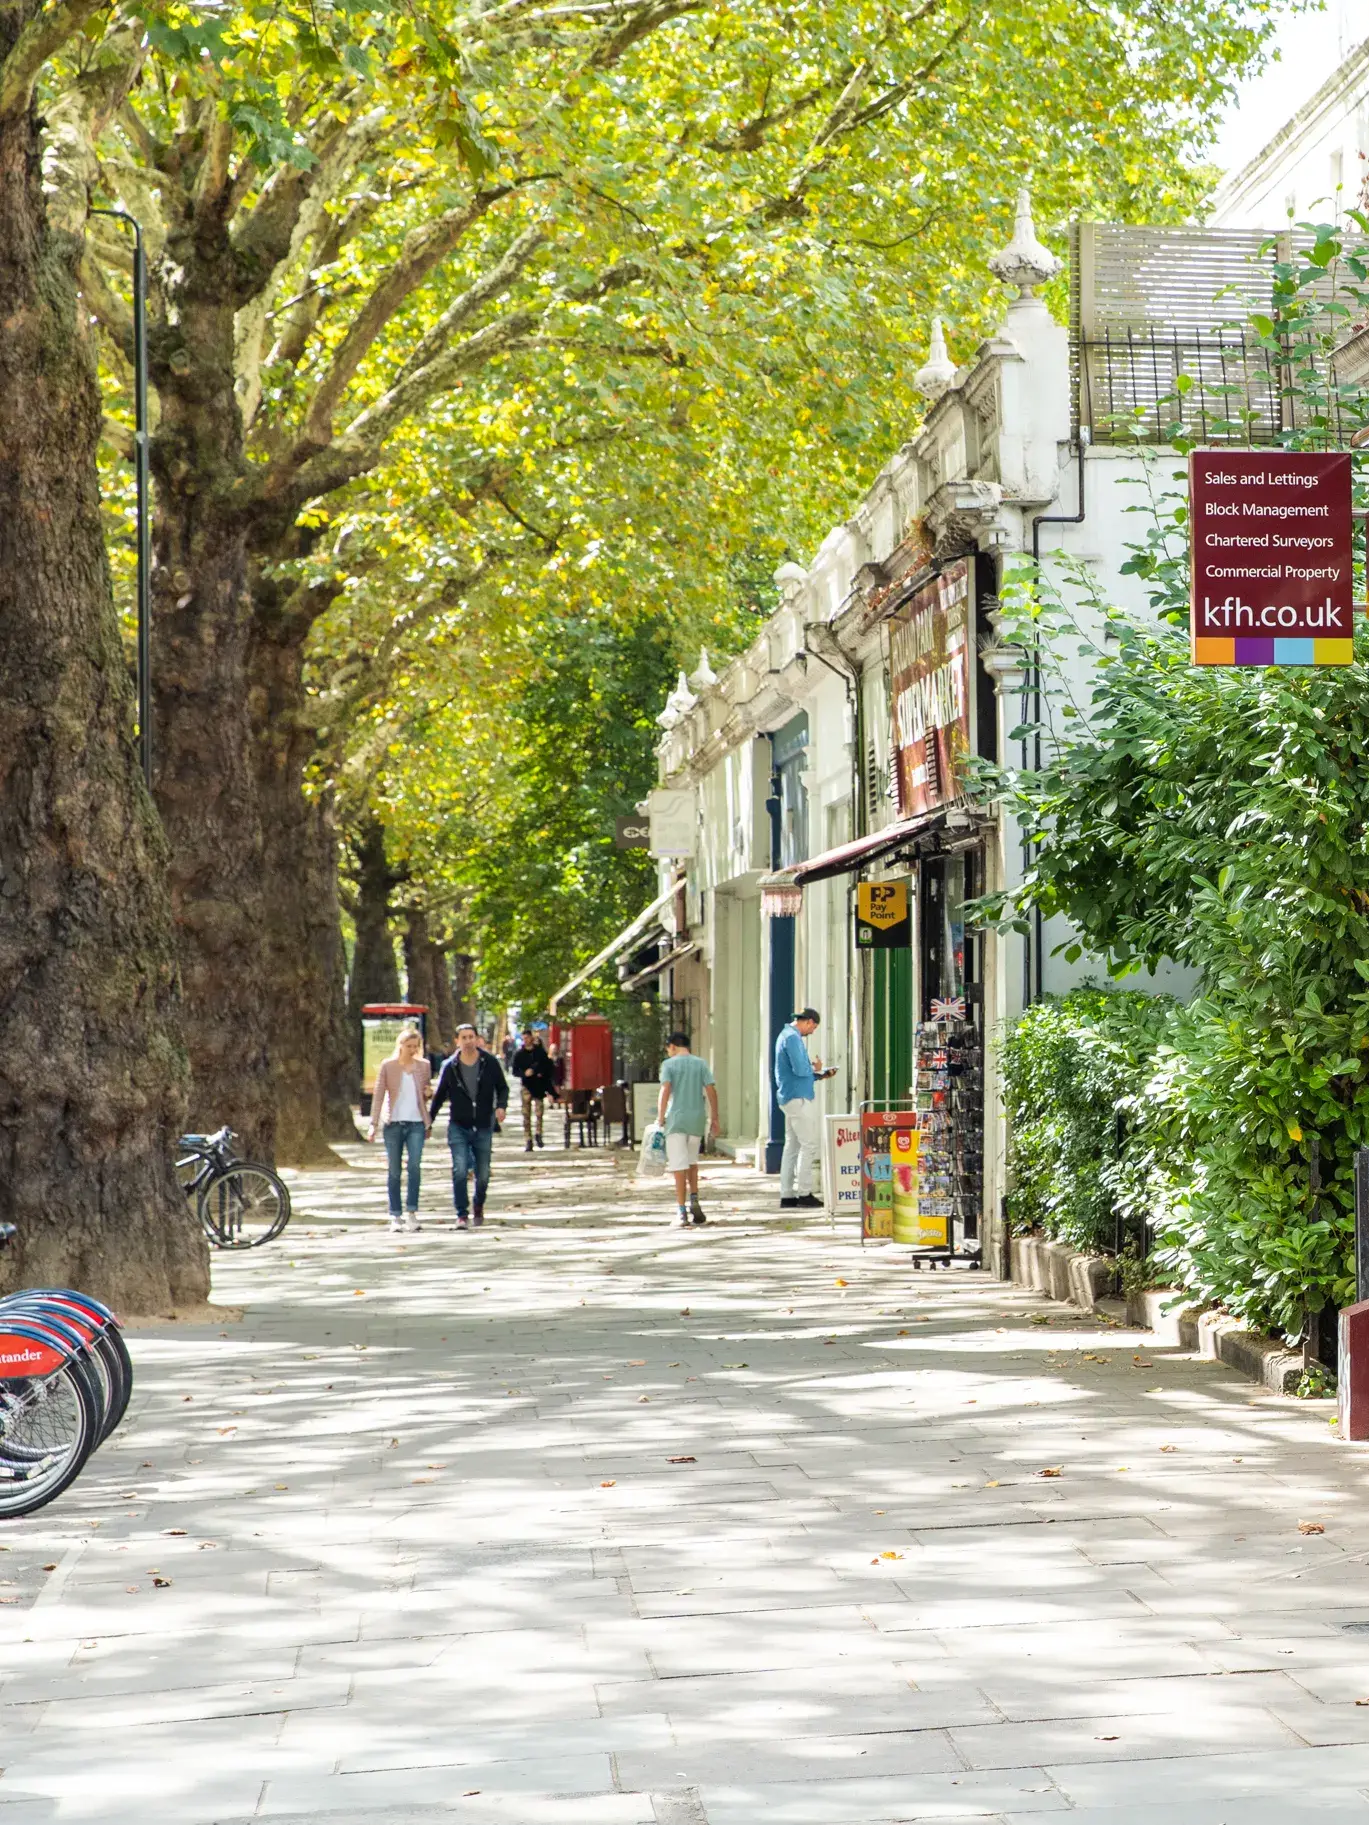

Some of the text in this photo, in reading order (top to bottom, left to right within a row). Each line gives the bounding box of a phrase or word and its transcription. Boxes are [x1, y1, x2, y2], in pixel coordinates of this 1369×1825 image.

[1205, 472, 1319, 488] Sales and Lettings
[1205, 503, 1329, 519] Block Management
[1205, 534, 1334, 550] Chartered Surveyors
[1205, 565, 1340, 581] Commercial Property
[1205, 597, 1342, 627] kfh.co.uk
[898, 653, 964, 750] SUPERMARKET
[870, 903, 887, 912] Pay
[870, 911, 896, 919] Point
[0, 1348, 42, 1364] tander
